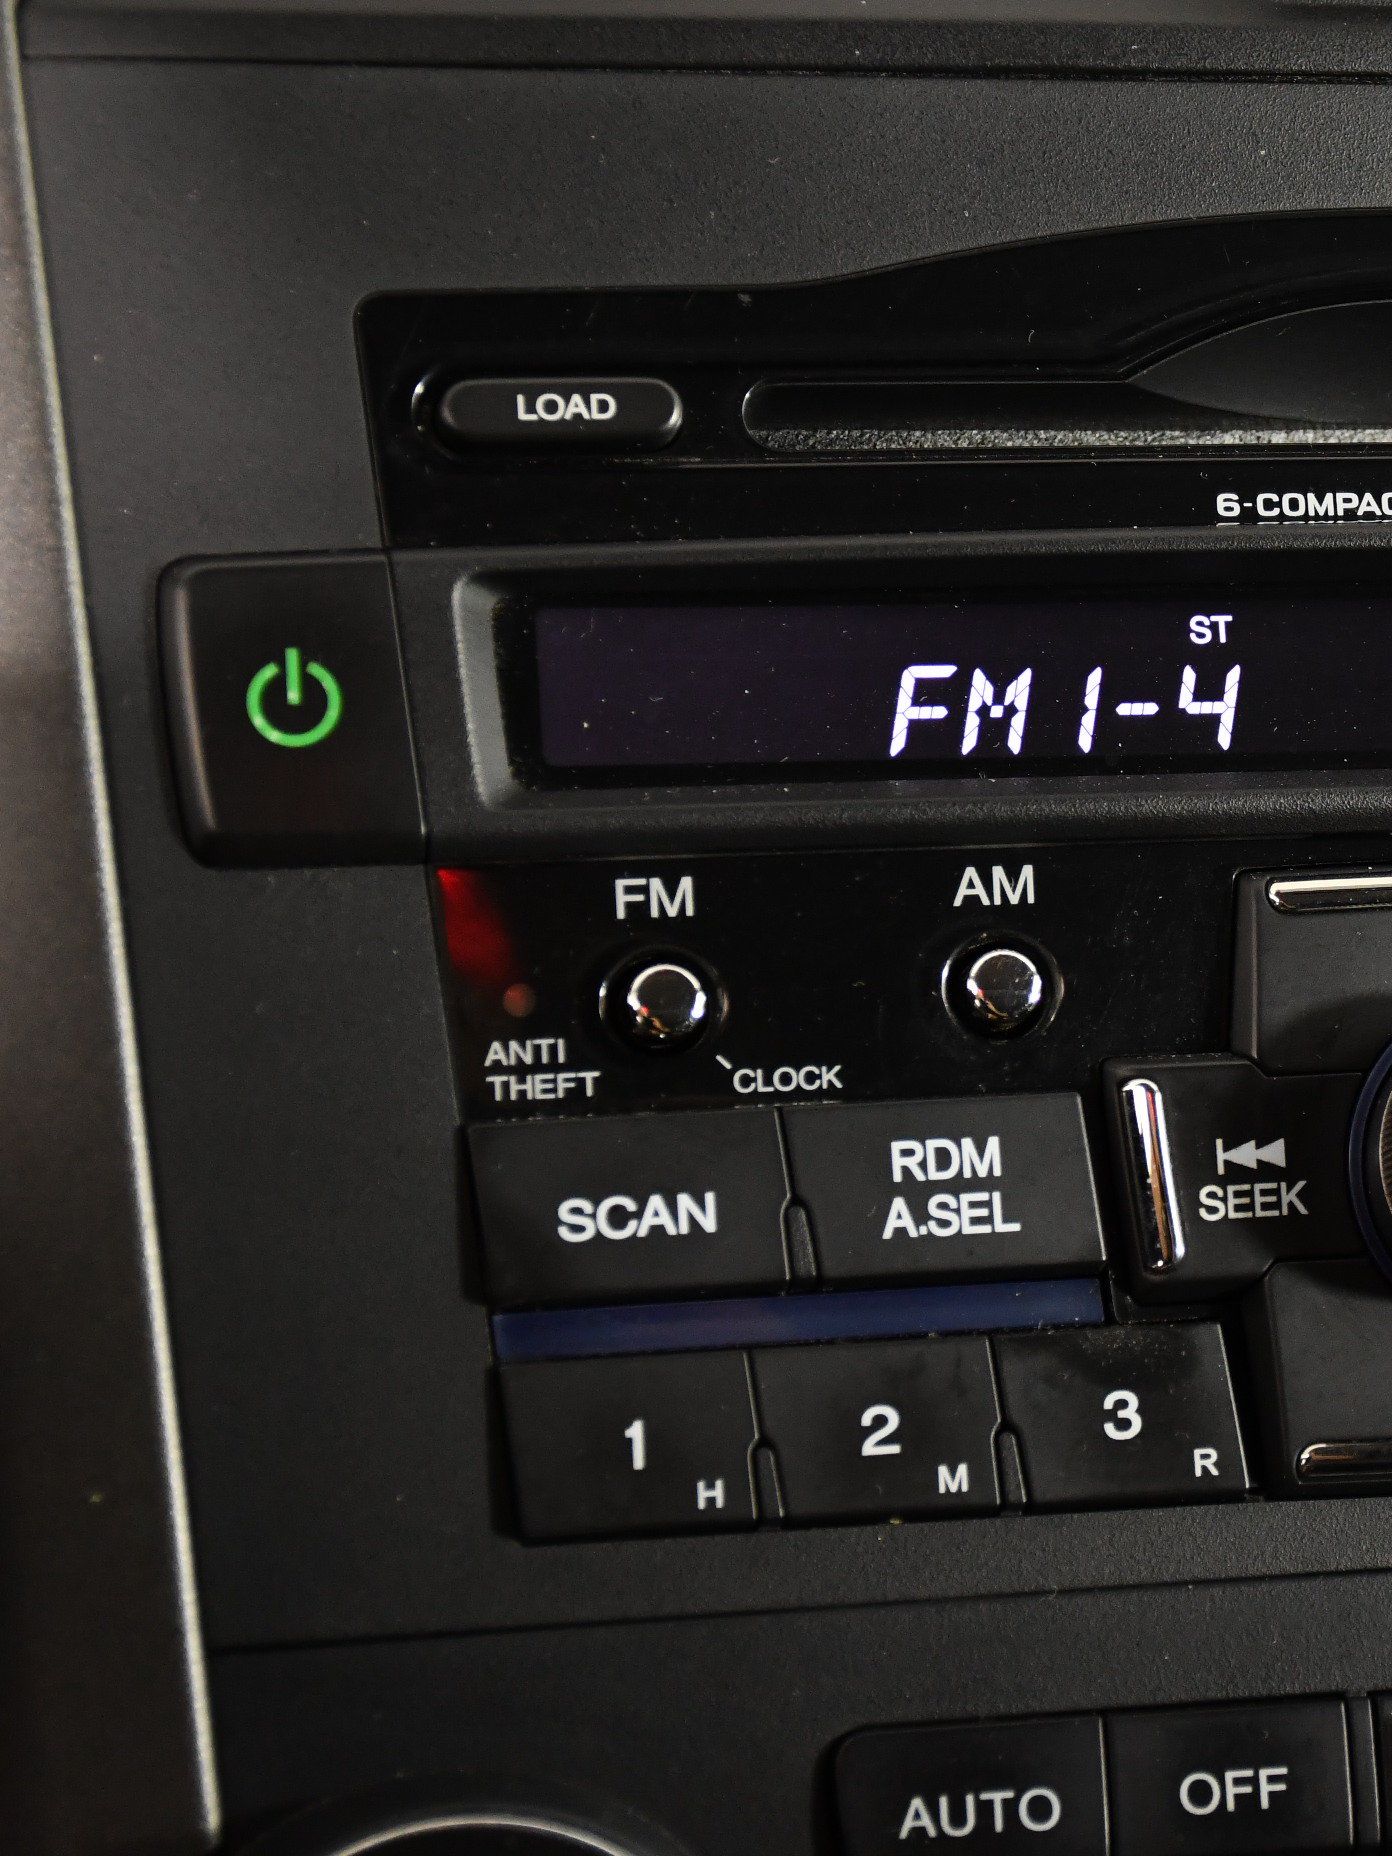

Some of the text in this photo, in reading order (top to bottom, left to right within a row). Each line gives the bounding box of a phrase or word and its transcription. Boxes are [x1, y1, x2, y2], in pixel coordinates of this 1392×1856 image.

[516, 392, 617, 422] LOAD
[1189, 614, 1233, 645] ST
[614, 875, 695, 920] FM
[952, 864, 1035, 907] AM
[483, 1037, 566, 1067] ANTI
[485, 1070, 601, 1102] THEFT
[731, 1063, 843, 1094] CLOCK
[890, 1135, 1002, 1183] RDM
[557, 1191, 718, 1243] SCAN
[882, 1190, 1022, 1240] A.SEL
[1198, 1180, 1309, 1222] SEEK
[860, 1404, 902, 1457] 2
[1103, 1389, 1143, 1441] 3
[624, 1419, 645, 1471] 1
[1193, 1447, 1220, 1478] R
[696, 1478, 725, 1510] H
[937, 1462, 969, 1494] M
[1179, 1766, 1289, 1816] OFF
[899, 1787, 1062, 1840] AUTO
